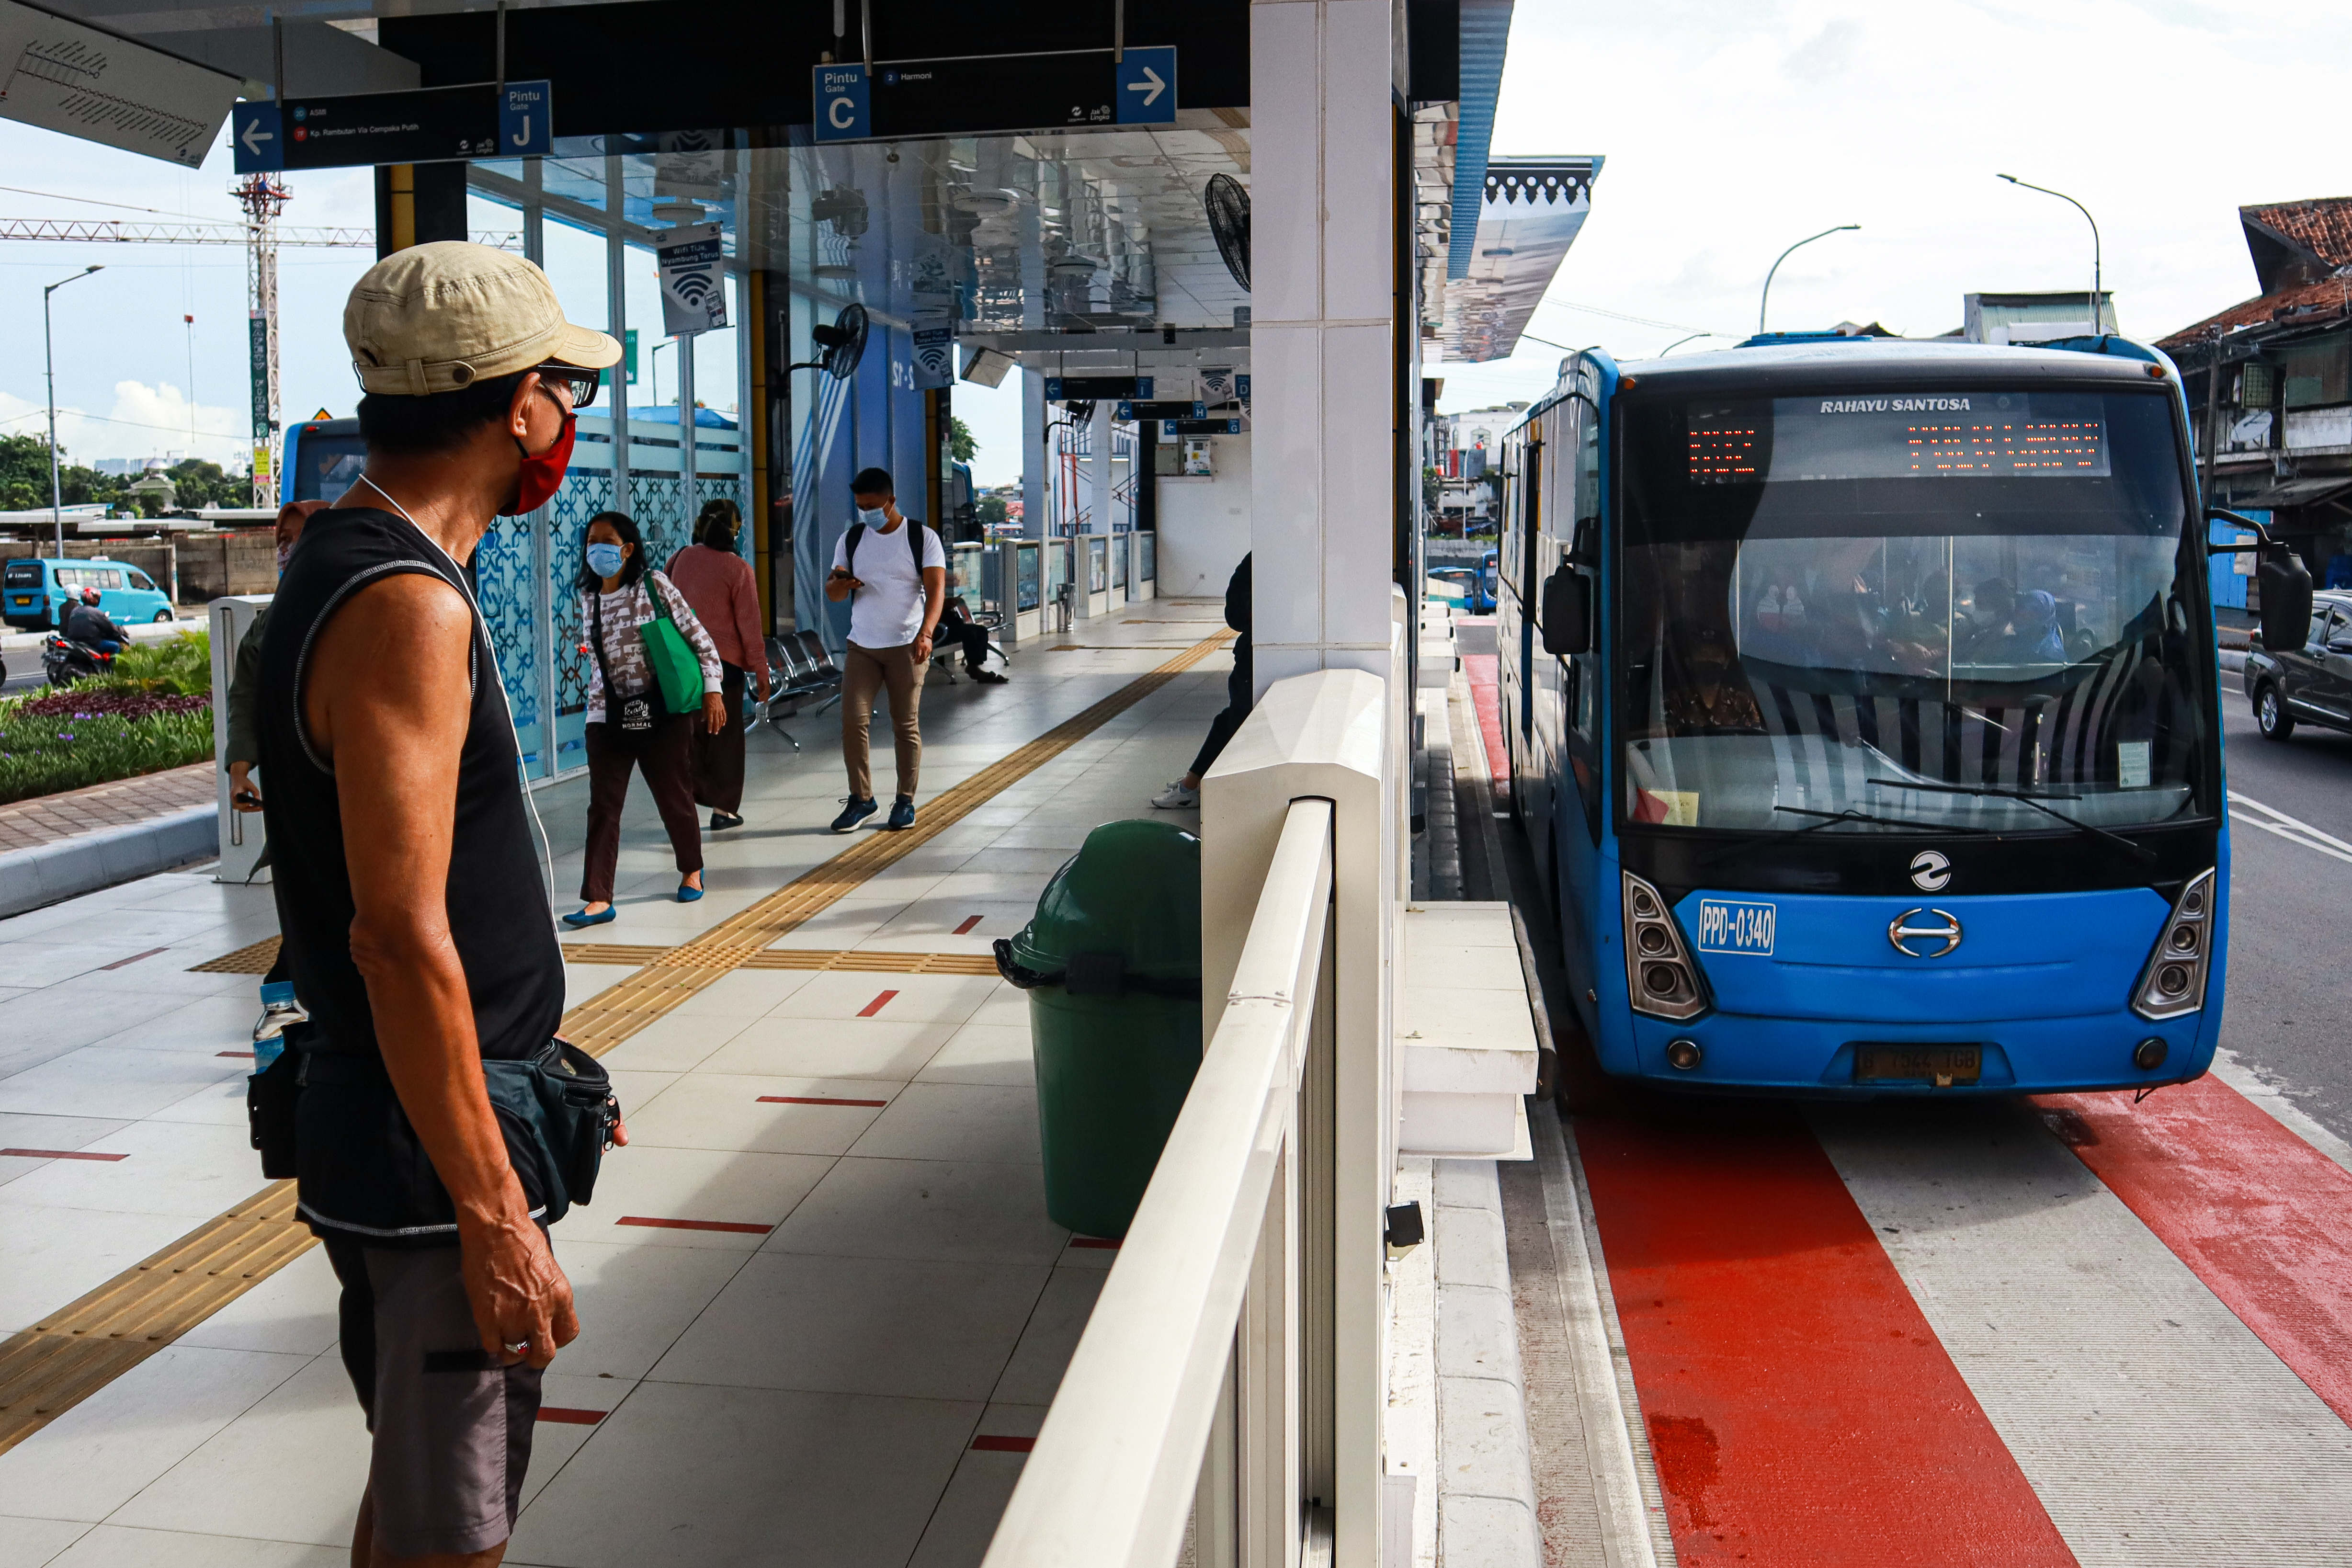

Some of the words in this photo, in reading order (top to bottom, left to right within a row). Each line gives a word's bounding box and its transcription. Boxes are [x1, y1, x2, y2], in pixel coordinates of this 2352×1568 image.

[824, 73, 857, 84] Pintu
[901, 72, 932, 80] Harmoni
[510, 91, 540, 102] Pintu
[829, 97, 854, 128] C
[512, 115, 530, 146] J
[1240, 385, 1248, 395] D
[1820, 399, 1887, 413] RAHAYU
[1892, 398, 1971, 411] SANTOSA
[1703, 906, 1772, 948] PPD-0340
